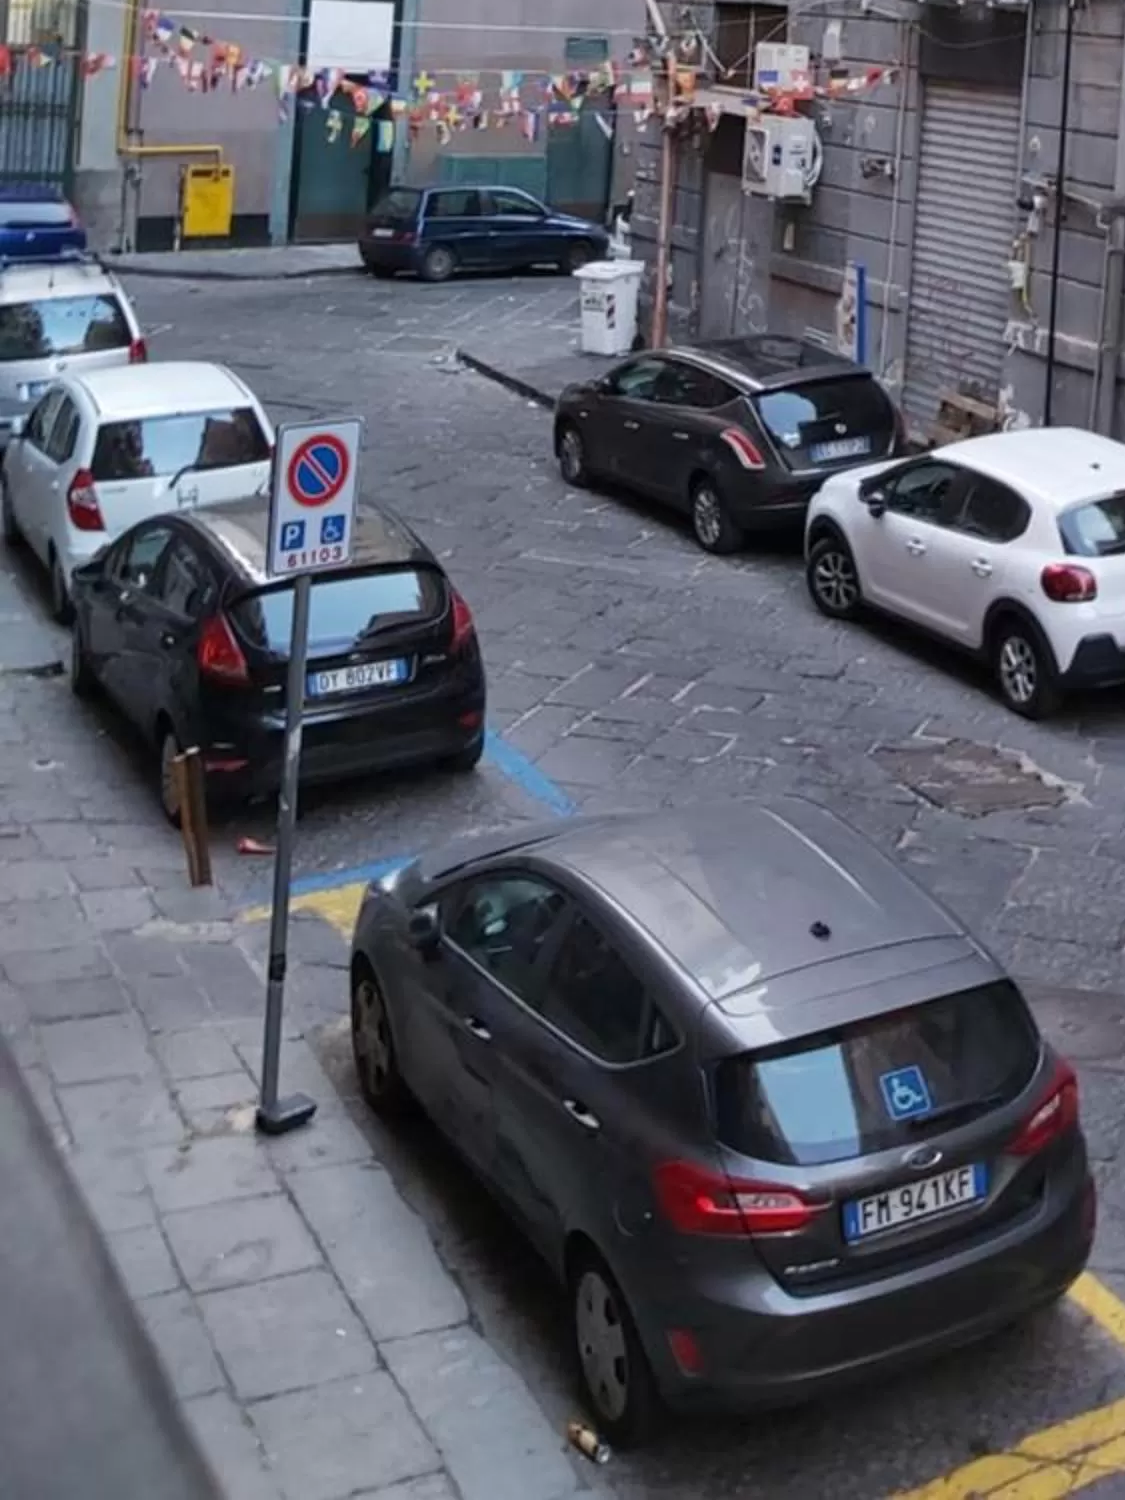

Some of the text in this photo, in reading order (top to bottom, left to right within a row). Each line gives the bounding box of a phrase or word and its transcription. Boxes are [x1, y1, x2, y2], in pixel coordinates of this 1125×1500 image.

[284, 524, 301, 548] P
[287, 545, 343, 568] 61103
[861, 1168, 972, 1231] FM 941KF
